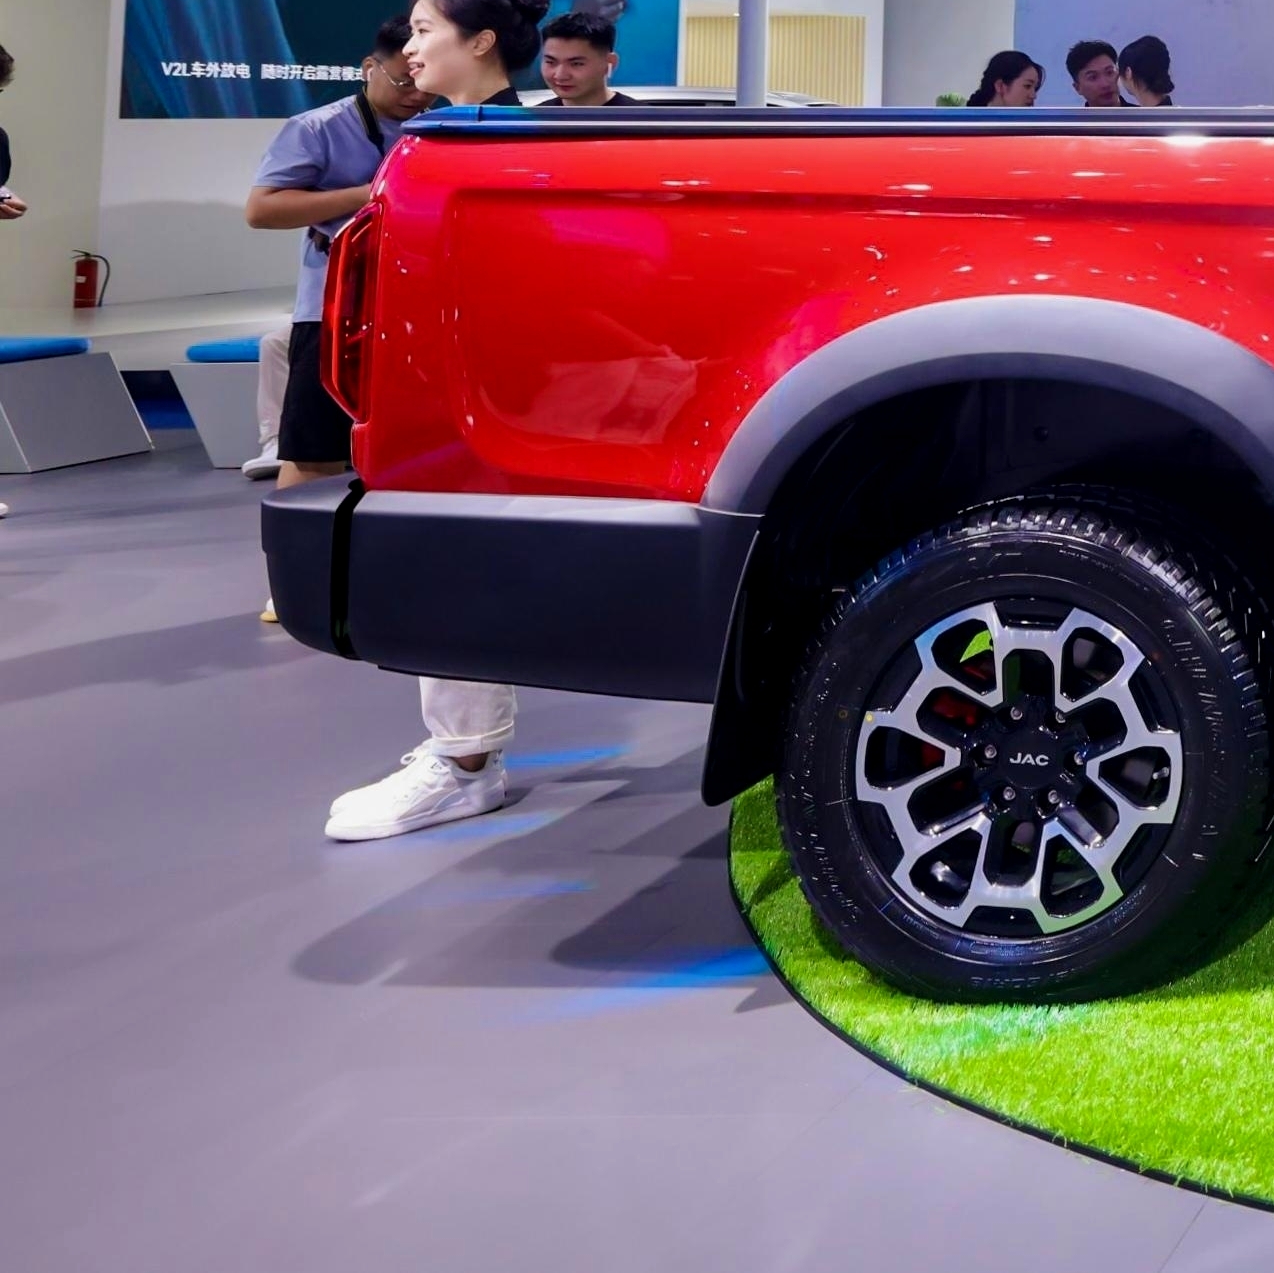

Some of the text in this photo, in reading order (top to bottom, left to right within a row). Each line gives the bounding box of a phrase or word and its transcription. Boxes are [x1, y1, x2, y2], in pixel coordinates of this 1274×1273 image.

[161, 61, 251, 79] V2L车外放电
[1009, 752, 1050, 767] JAC
